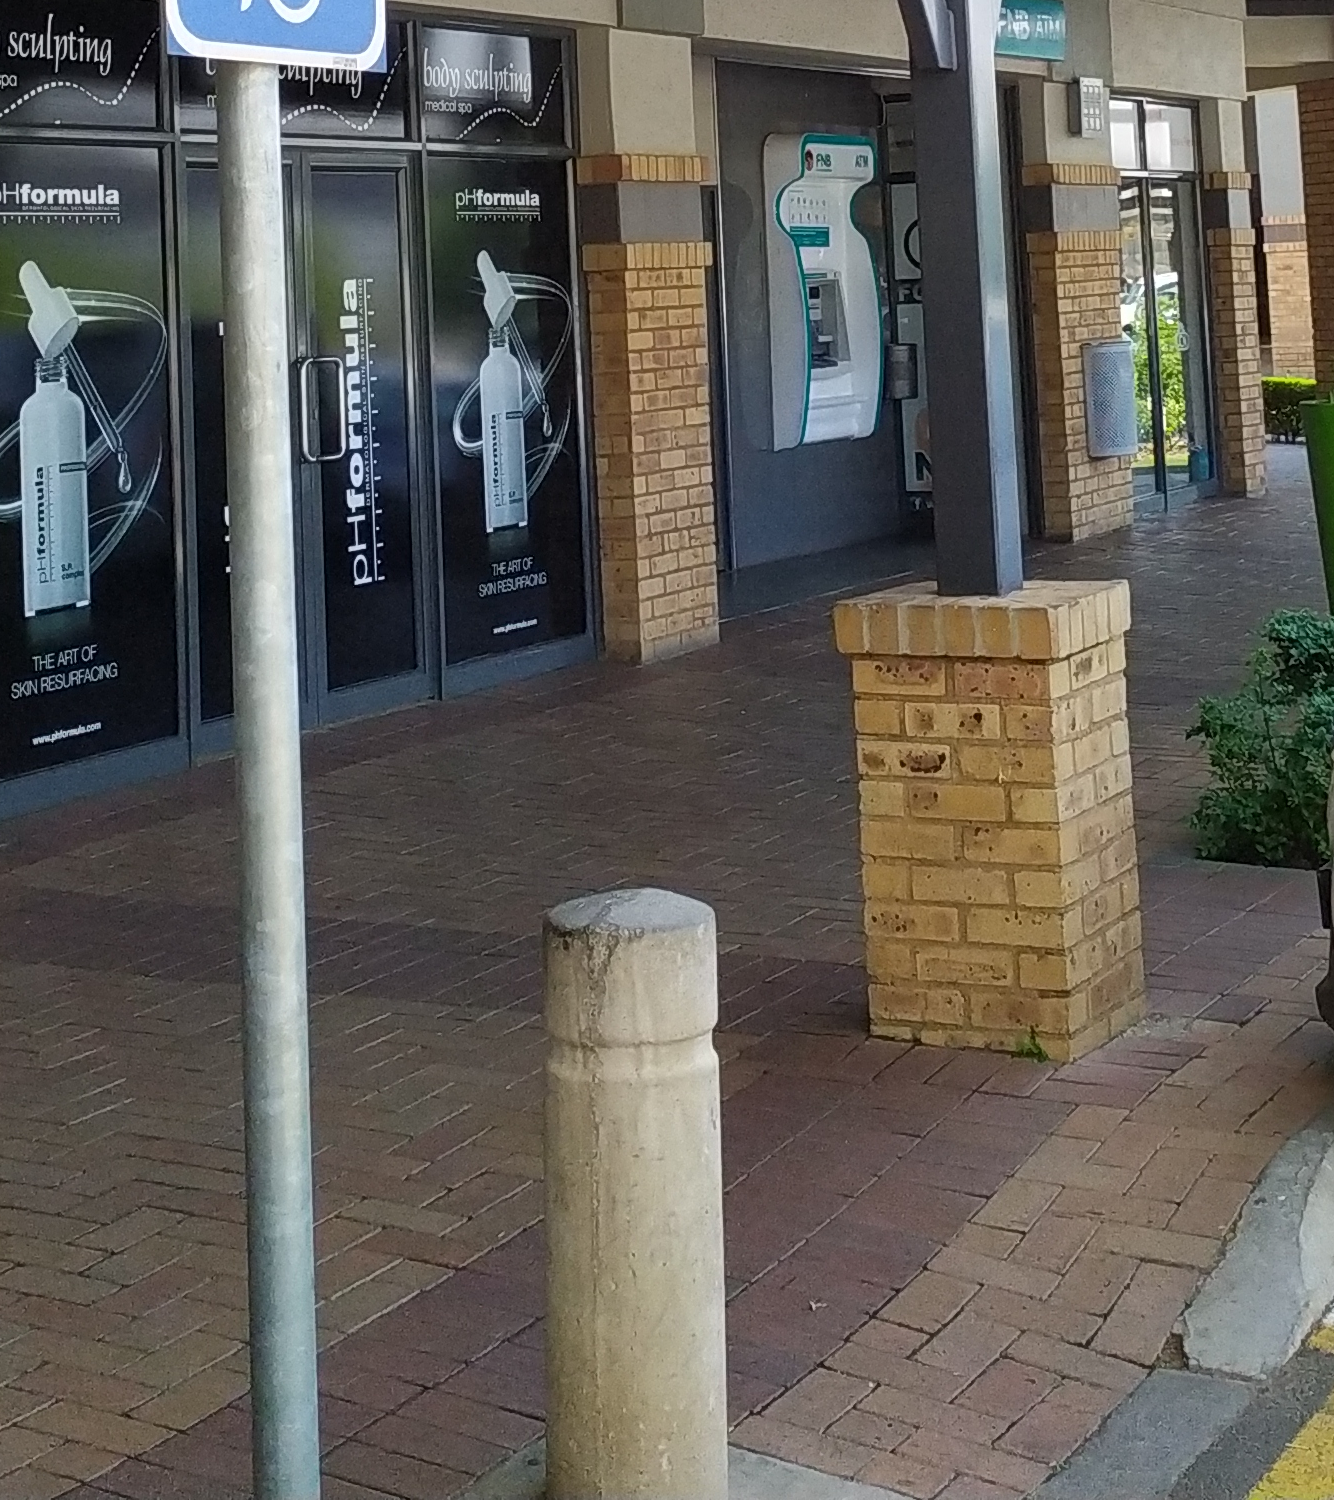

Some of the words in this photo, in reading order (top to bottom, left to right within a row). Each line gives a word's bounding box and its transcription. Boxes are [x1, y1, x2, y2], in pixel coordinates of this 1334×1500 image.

[997, 6, 1030, 40] FNB
[7, 13, 112, 76] sculpting
[423, 47, 460, 98] body
[464, 53, 533, 104] sculpting
[424, 99, 457, 113] medical
[457, 102, 473, 116] spa
[815, 153, 832, 168] FNB
[855, 154, 869, 168] ATM
[455, 189, 540, 209] pHformula
[339, 278, 373, 586] pHformula
[35, 466, 49, 584] pHformula
[491, 562, 507, 577] THE
[507, 559, 521, 574] ART
[522, 556, 534, 571] OF
[479, 582, 497, 598] SKIN
[497, 571, 547, 594] RESURFACING
[32, 652, 56, 672] THE
[57, 647, 80, 668] ART
[81, 644, 98, 662] OF
[10, 679, 38, 699] SKIN
[40, 662, 119, 693] RESURFACING
